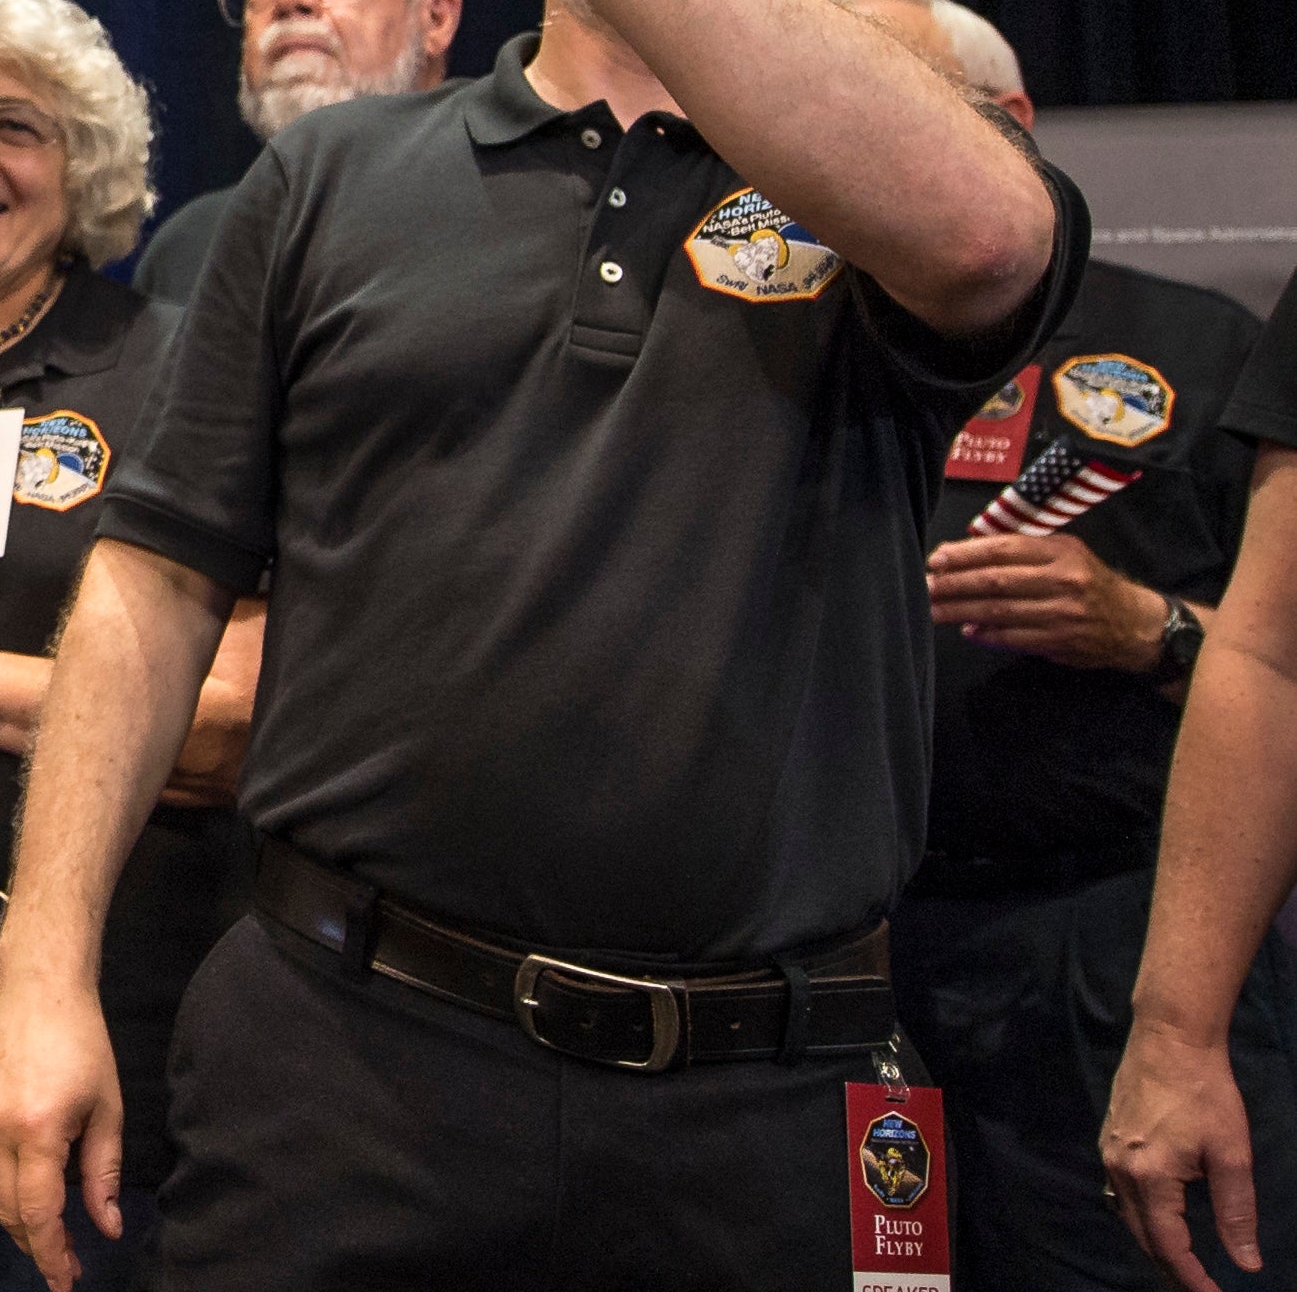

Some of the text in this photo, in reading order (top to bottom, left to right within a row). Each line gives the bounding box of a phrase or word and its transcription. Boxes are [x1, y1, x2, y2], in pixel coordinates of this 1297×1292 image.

[739, 193, 762, 206] NE
[718, 200, 773, 221] HORIZ
[750, 208, 781, 224] Pluto
[730, 215, 790, 237] Belt Miss
[756, 283, 798, 296] NASA
[872, 1128, 917, 1139] HORIZONS
[874, 1214, 923, 1237] PLUTO
[875, 1234, 924, 1257] FLYBY
